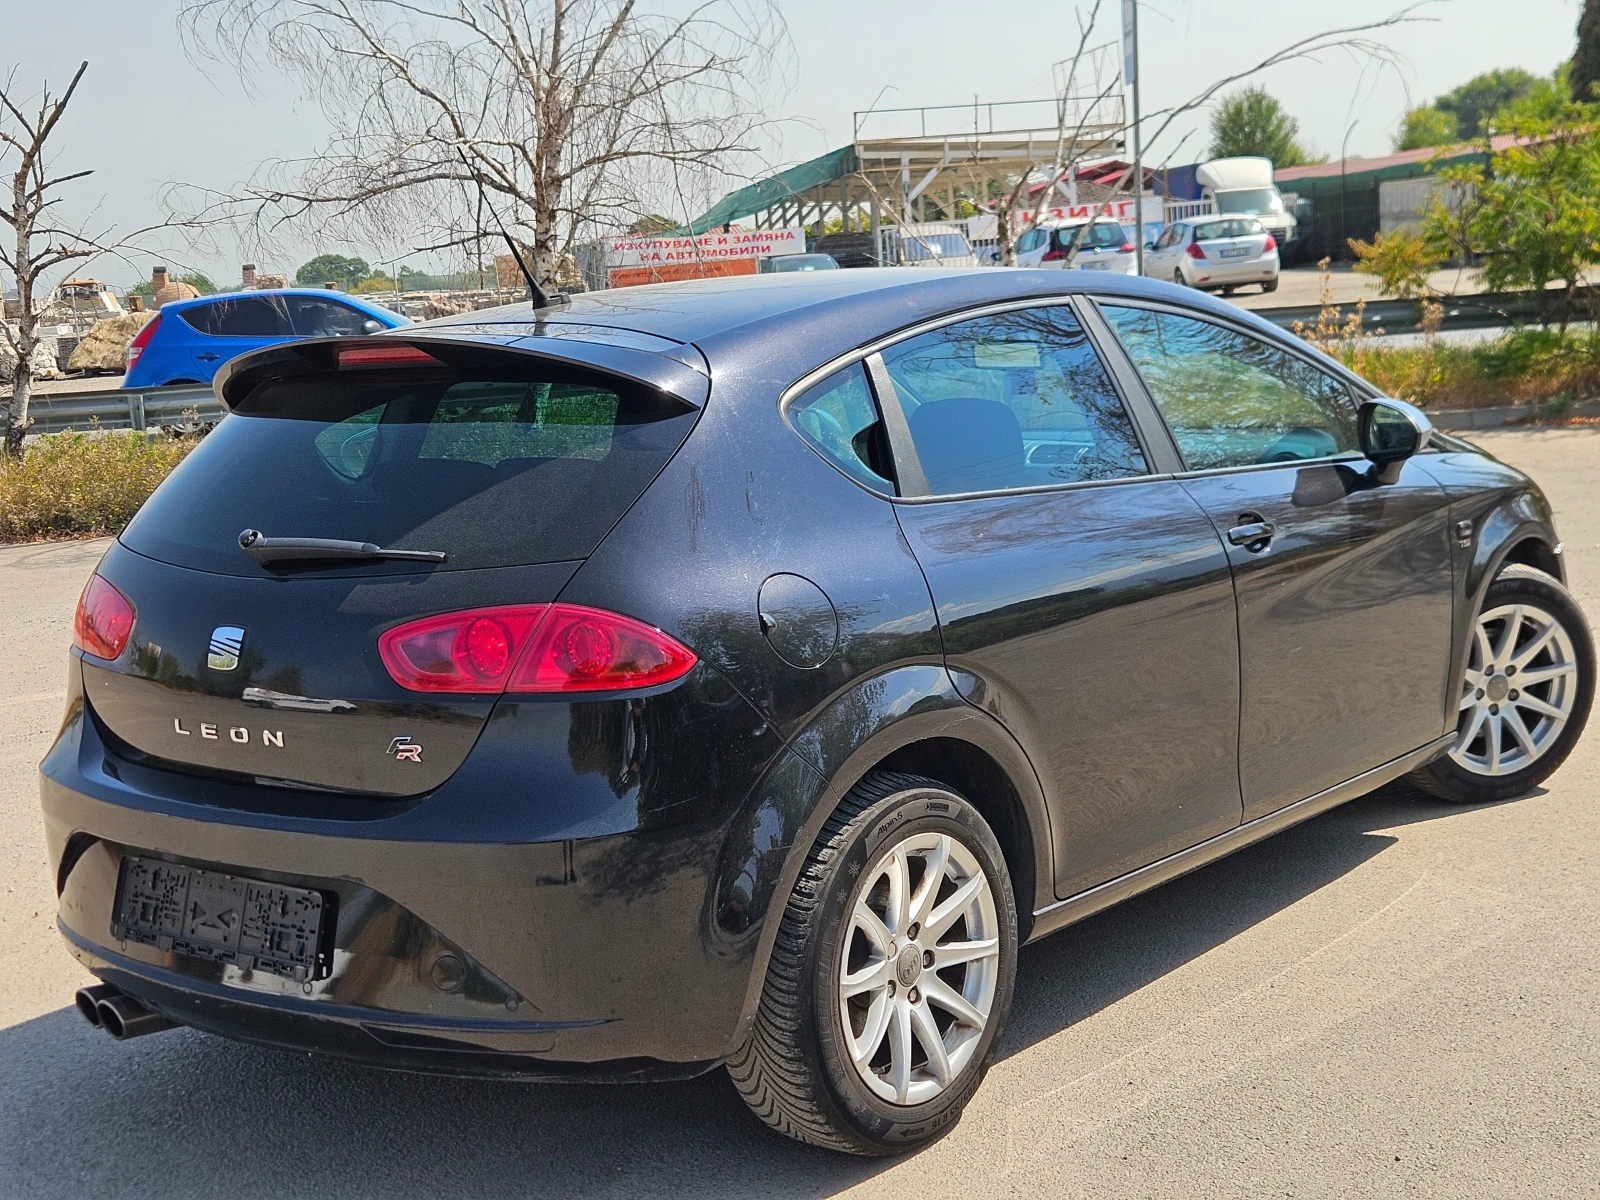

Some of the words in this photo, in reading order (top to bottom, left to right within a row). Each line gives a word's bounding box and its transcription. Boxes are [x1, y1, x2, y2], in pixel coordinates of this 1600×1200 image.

[614, 238, 712, 251] ИЗКУПУВАНЕ
[717, 237, 728, 246] И
[733, 232, 795, 245] ЗАМЯНА
[640, 251, 661, 261] НА
[665, 245, 771, 260] АВТОМОБИЛИ
[174, 718, 285, 748] LEON
[386, 736, 423, 763] FR
